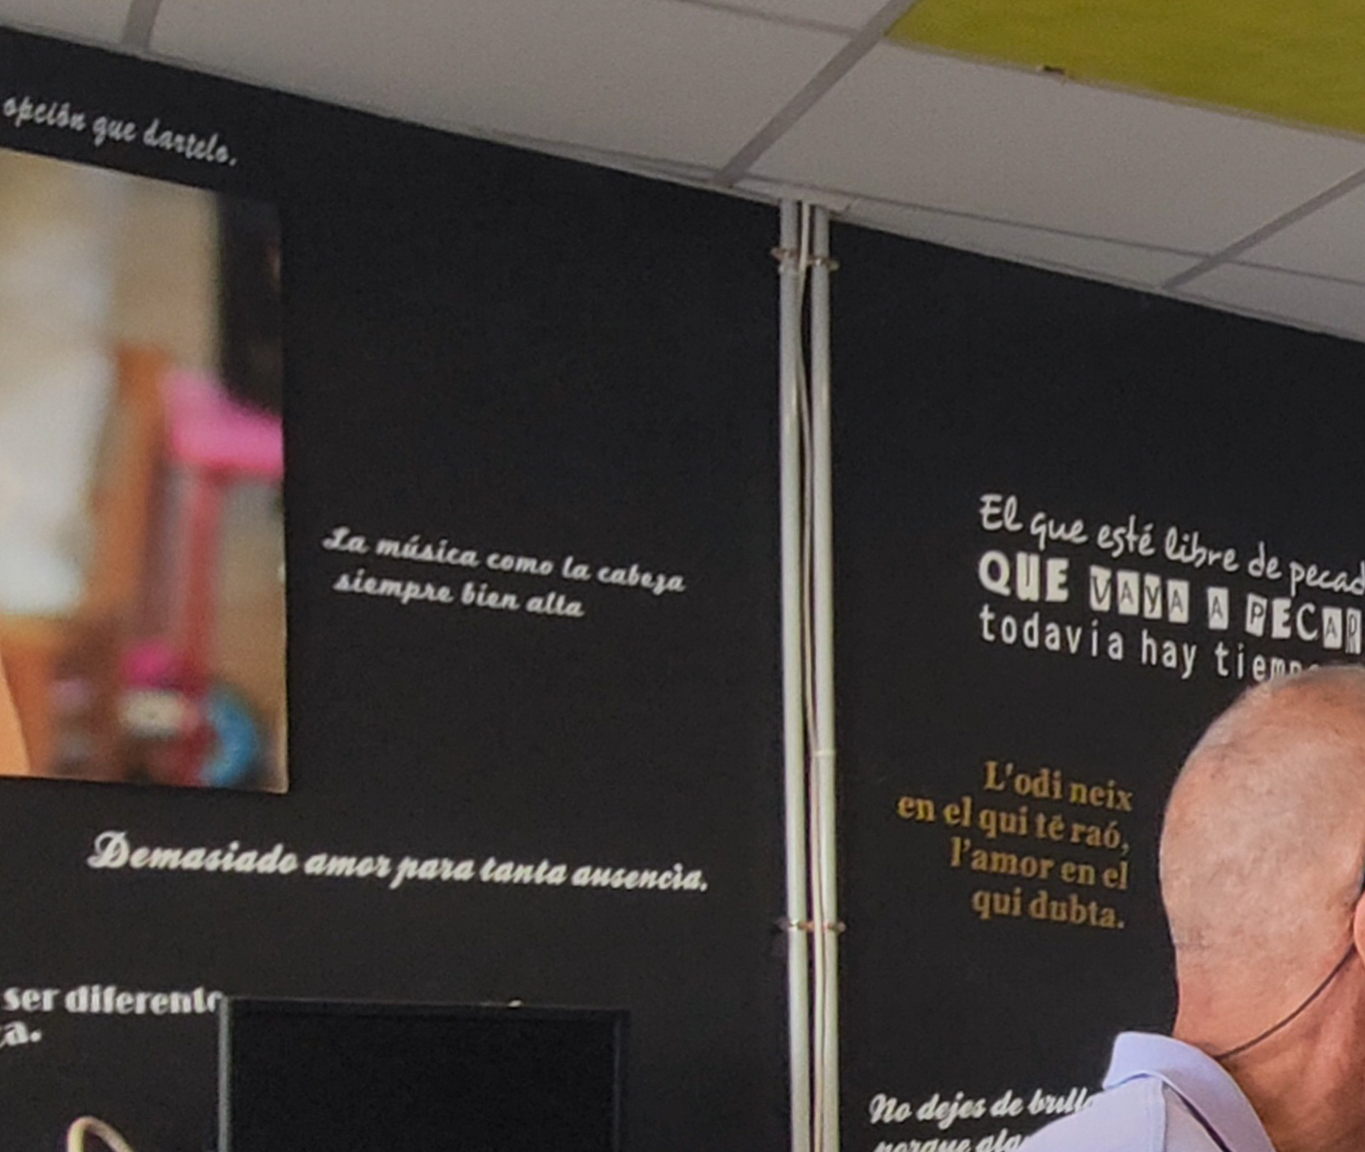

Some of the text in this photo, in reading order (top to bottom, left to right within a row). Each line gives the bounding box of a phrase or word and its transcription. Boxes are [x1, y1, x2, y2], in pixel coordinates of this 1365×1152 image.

[93, 116, 136, 146] que
[979, 494, 1023, 532] El
[1031, 512, 1088, 550] que
[1097, 515, 1155, 558] esté
[1165, 527, 1240, 572] libre
[1247, 541, 1282, 579] de
[322, 527, 686, 596] La música como la cabeza
[334, 569, 584, 618] siempre bien alta
[978, 550, 1069, 602] QUE
[1207, 586, 1229, 630] A
[1142, 630, 1197, 679] hay
[1215, 642, 1319, 683] tiem
[984, 760, 1134, 811] L'odi neix
[898, 795, 935, 822] en
[944, 796, 971, 827] el
[978, 806, 1028, 839] qui
[88, 831, 298, 874] Demasiado
[304, 853, 391, 878] amor
[390, 857, 475, 889] para
[480, 857, 568, 882] tanta
[1061, 863, 1095, 886] en
[1102, 861, 1128, 889] el
[971, 887, 1124, 929] qui dubta.
[3, 987, 60, 1012] ser
[869, 1087, 1094, 1130] No dejes de brill
